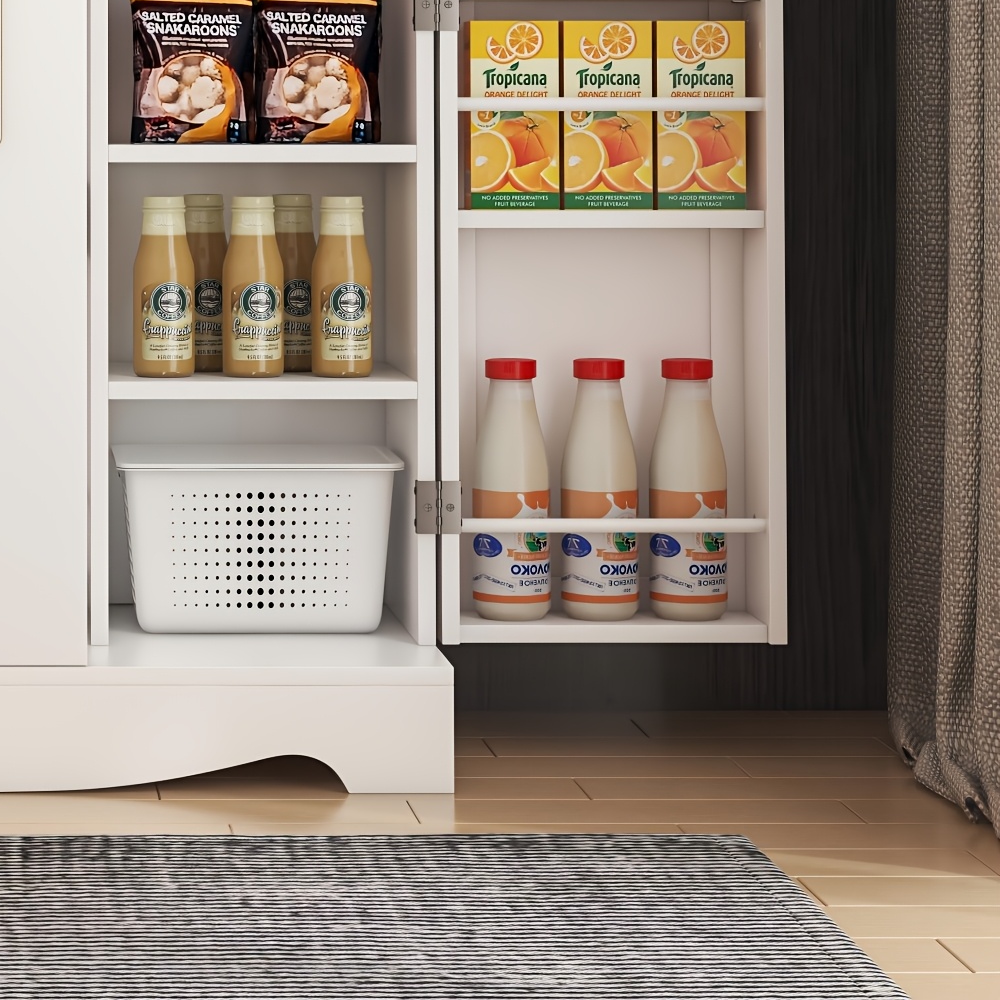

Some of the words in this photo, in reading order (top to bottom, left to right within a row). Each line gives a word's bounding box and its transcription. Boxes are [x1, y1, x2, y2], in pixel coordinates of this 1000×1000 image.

[140, 11, 186, 23] SALTED
[188, 13, 242, 24] CARAMEL
[265, 11, 311, 23] SALTED
[313, 13, 367, 24] CARAMEL
[146, 22, 238, 37] SNAKAROONS
[271, 22, 363, 37] SNAKAROONS
[482, 68, 547, 89] Tropicana
[575, 68, 640, 89] Tropicana
[669, 68, 733, 89] Tropicana
[161, 285, 180, 293] STAR
[250, 285, 270, 293] STAR
[340, 285, 359, 293] STAR
